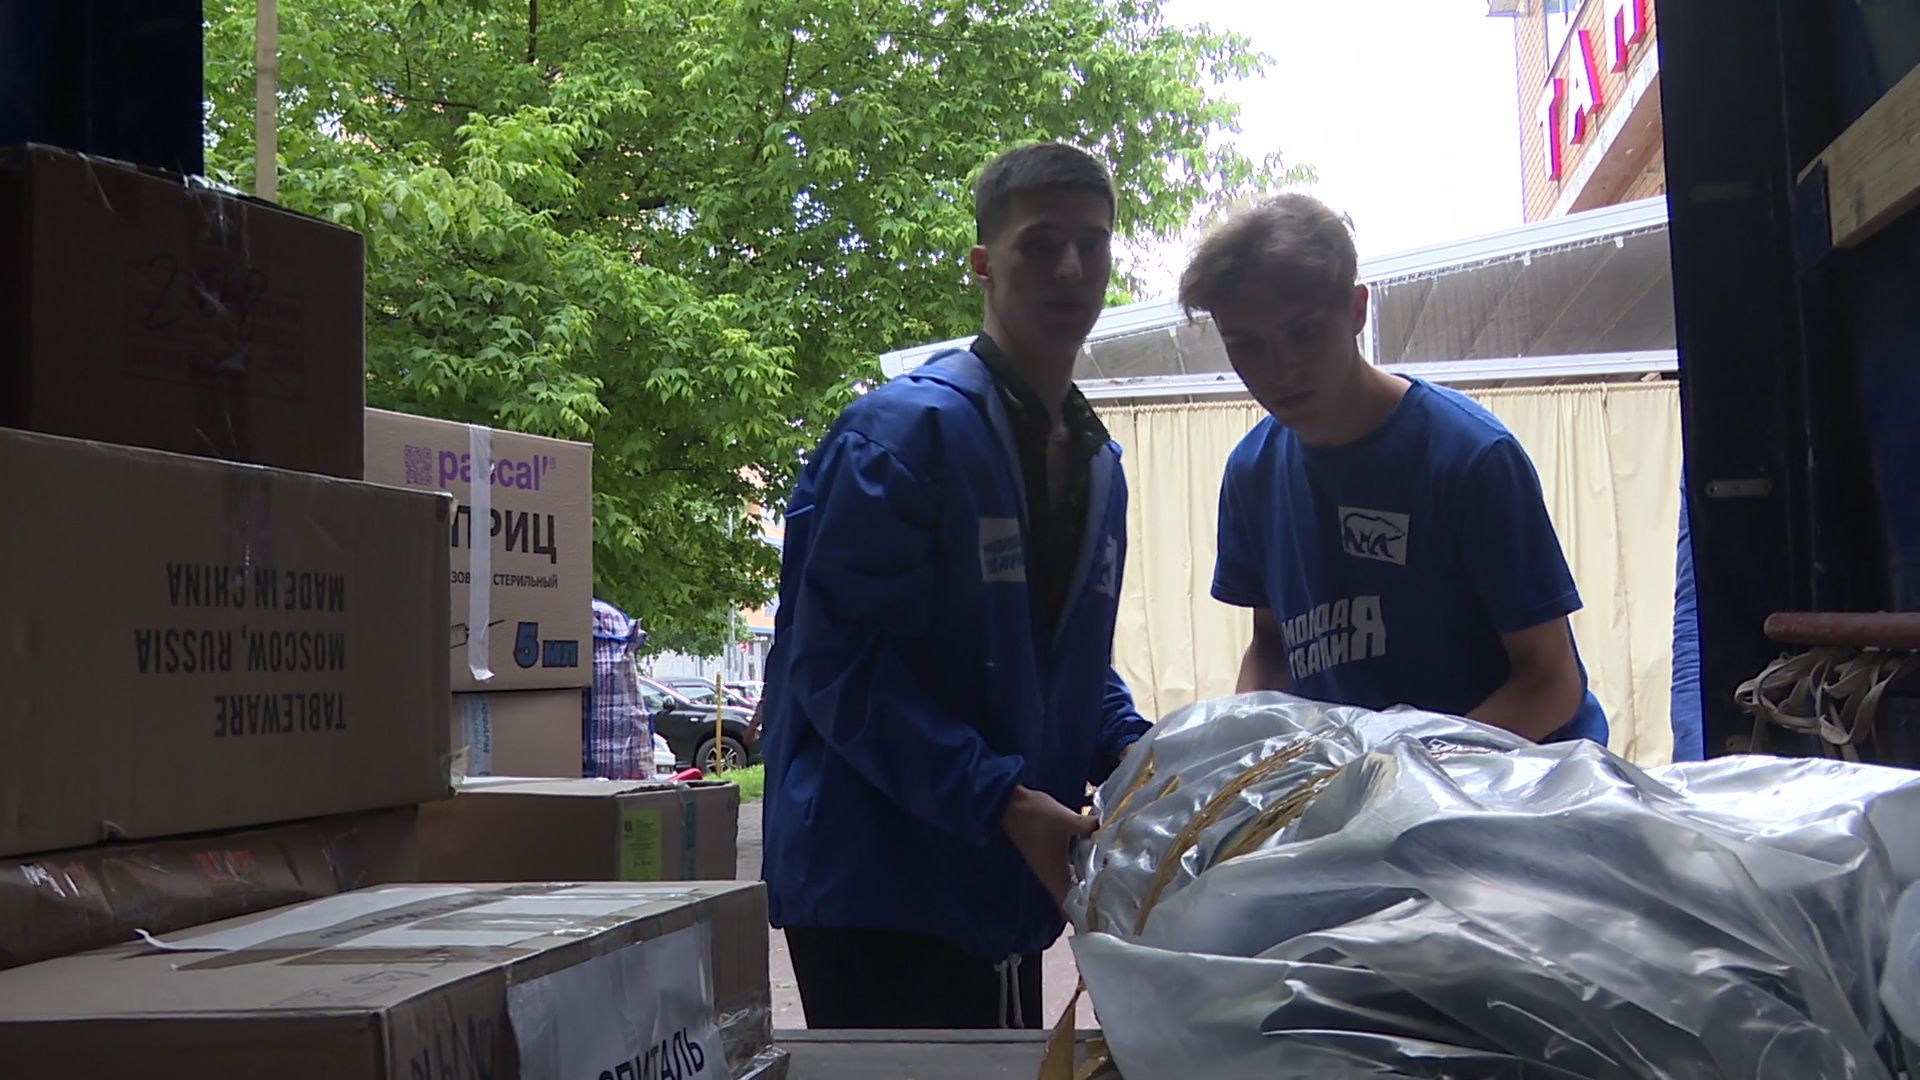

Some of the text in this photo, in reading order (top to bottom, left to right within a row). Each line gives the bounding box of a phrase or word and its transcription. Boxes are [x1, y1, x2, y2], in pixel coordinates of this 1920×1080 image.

[438, 449, 541, 491] pacal
[451, 505, 557, 565] ПРИЦ
[166, 562, 345, 612] MADE IN CHINA
[493, 572, 559, 589] СТЕРИЛЬНЫЙ
[134, 624, 345, 674] MOSCOW, RUSSIA
[513, 621, 540, 668] 5
[214, 692, 347, 738] TABLEWARE
